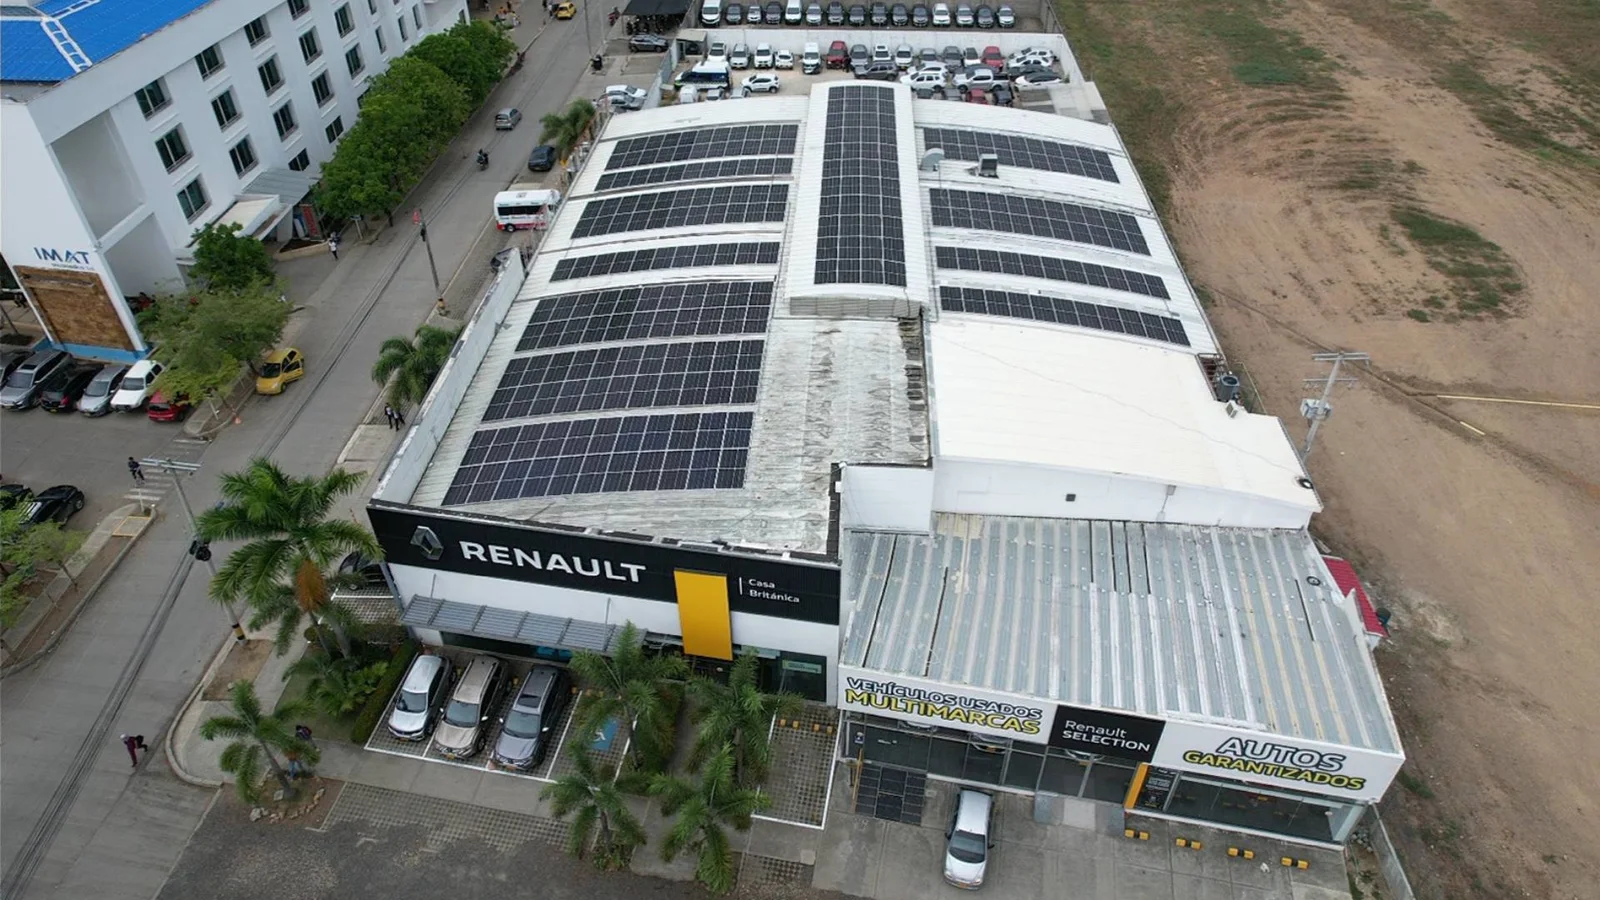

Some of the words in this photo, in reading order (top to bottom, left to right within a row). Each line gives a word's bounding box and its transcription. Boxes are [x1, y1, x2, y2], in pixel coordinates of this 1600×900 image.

[33, 247, 89, 264] IMAT
[459, 541, 646, 582] RENAULT
[748, 578, 776, 589] Casa
[749, 589, 800, 603] Británica
[845, 688, 1041, 735] MULTIMARCAS
[846, 676, 957, 706] VEHÍCULOS
[959, 694, 1043, 720] USADOS
[1062, 730, 1151, 752] SELECTION
[1064, 720, 1128, 739] Renault
[1215, 736, 1347, 772] AUTOS
[1182, 750, 1367, 790] GARANTIZADOS
